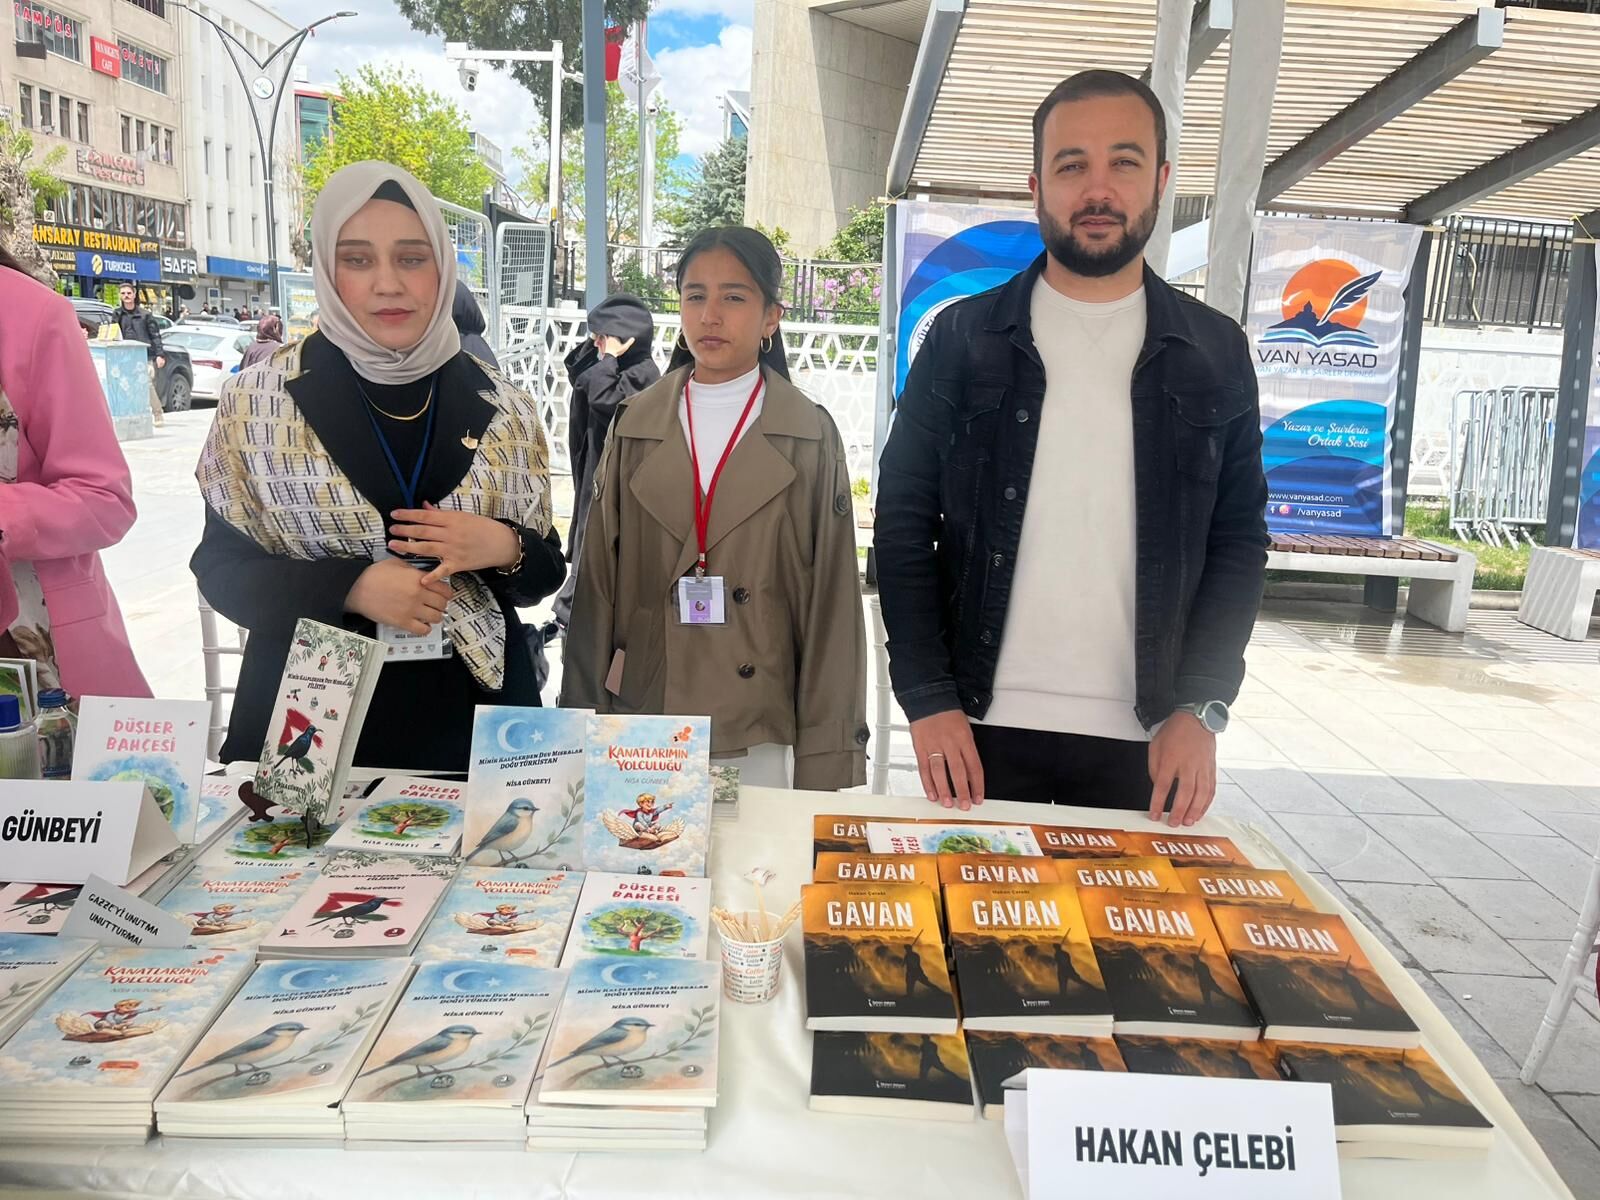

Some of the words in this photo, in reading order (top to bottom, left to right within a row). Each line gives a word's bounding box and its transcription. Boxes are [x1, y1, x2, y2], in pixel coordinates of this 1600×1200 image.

[32, 223, 81, 247] ANSARAY
[83, 230, 141, 254] RESTAURANT
[104, 260, 137, 273] TURKCELL
[1257, 349, 1300, 365] VAN
[1307, 351, 1378, 369] YASAD
[1282, 420, 1311, 433] Yazar
[1314, 425, 1325, 433] ve
[1346, 435, 1370, 448] Sesi
[1267, 493, 1344, 502] www.vanyasad.com
[113, 717, 173, 735] DÜŞLER
[106, 736, 176, 753] BAHÇESİ
[608, 745, 688, 760] KANATLARIMIN
[519, 757, 559, 768] TÜRKİSTAN
[616, 759, 682, 771] YOLCULUĞU
[505, 779, 521, 787] NİSA
[2, 809, 104, 844] GÜNBEYİ
[1044, 831, 1118, 849] GAVAN
[1151, 840, 1226, 858] GAVAN
[838, 862, 916, 881] GAVAN
[960, 864, 1040, 883] GAVAN
[1076, 868, 1159, 888] GAVAN
[619, 882, 676, 893] DÜŞLER
[1198, 877, 1284, 897] GAVAN
[612, 891, 680, 902] BAHÇESİ
[827, 901, 914, 927] GAVAN
[972, 900, 1061, 926] GAVAN
[1104, 905, 1195, 936] GAVAN
[89, 912, 143, 946] UNUTTURMA!
[124, 912, 159, 936] UNUTMA
[1243, 922, 1340, 953] GAVAN
[104, 966, 209, 977] KANATLARIMIN
[1075, 1126, 1183, 1166] HAKAN
[1193, 1125, 1296, 1177] ÇELEBİ
